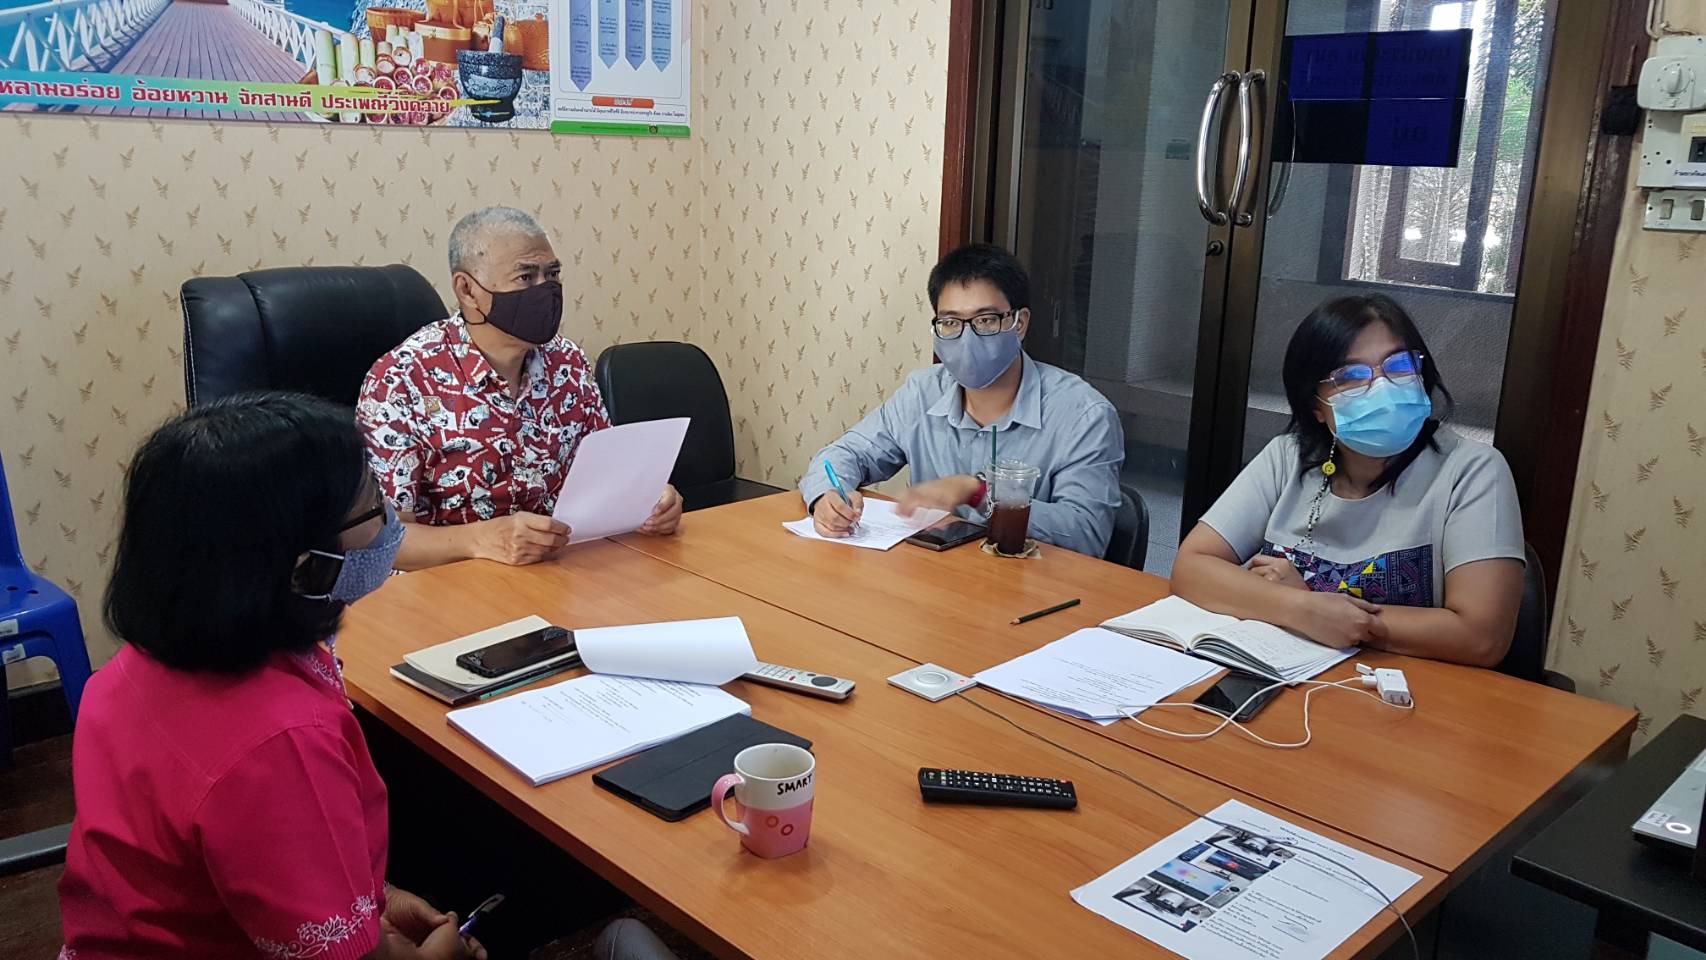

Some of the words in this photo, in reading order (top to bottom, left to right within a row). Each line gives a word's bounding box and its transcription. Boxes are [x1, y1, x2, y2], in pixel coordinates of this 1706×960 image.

[132, 80, 229, 103] อ้อยหวาน
[238, 88, 312, 107] จักสานดี
[776, 774, 813, 795] SMART
